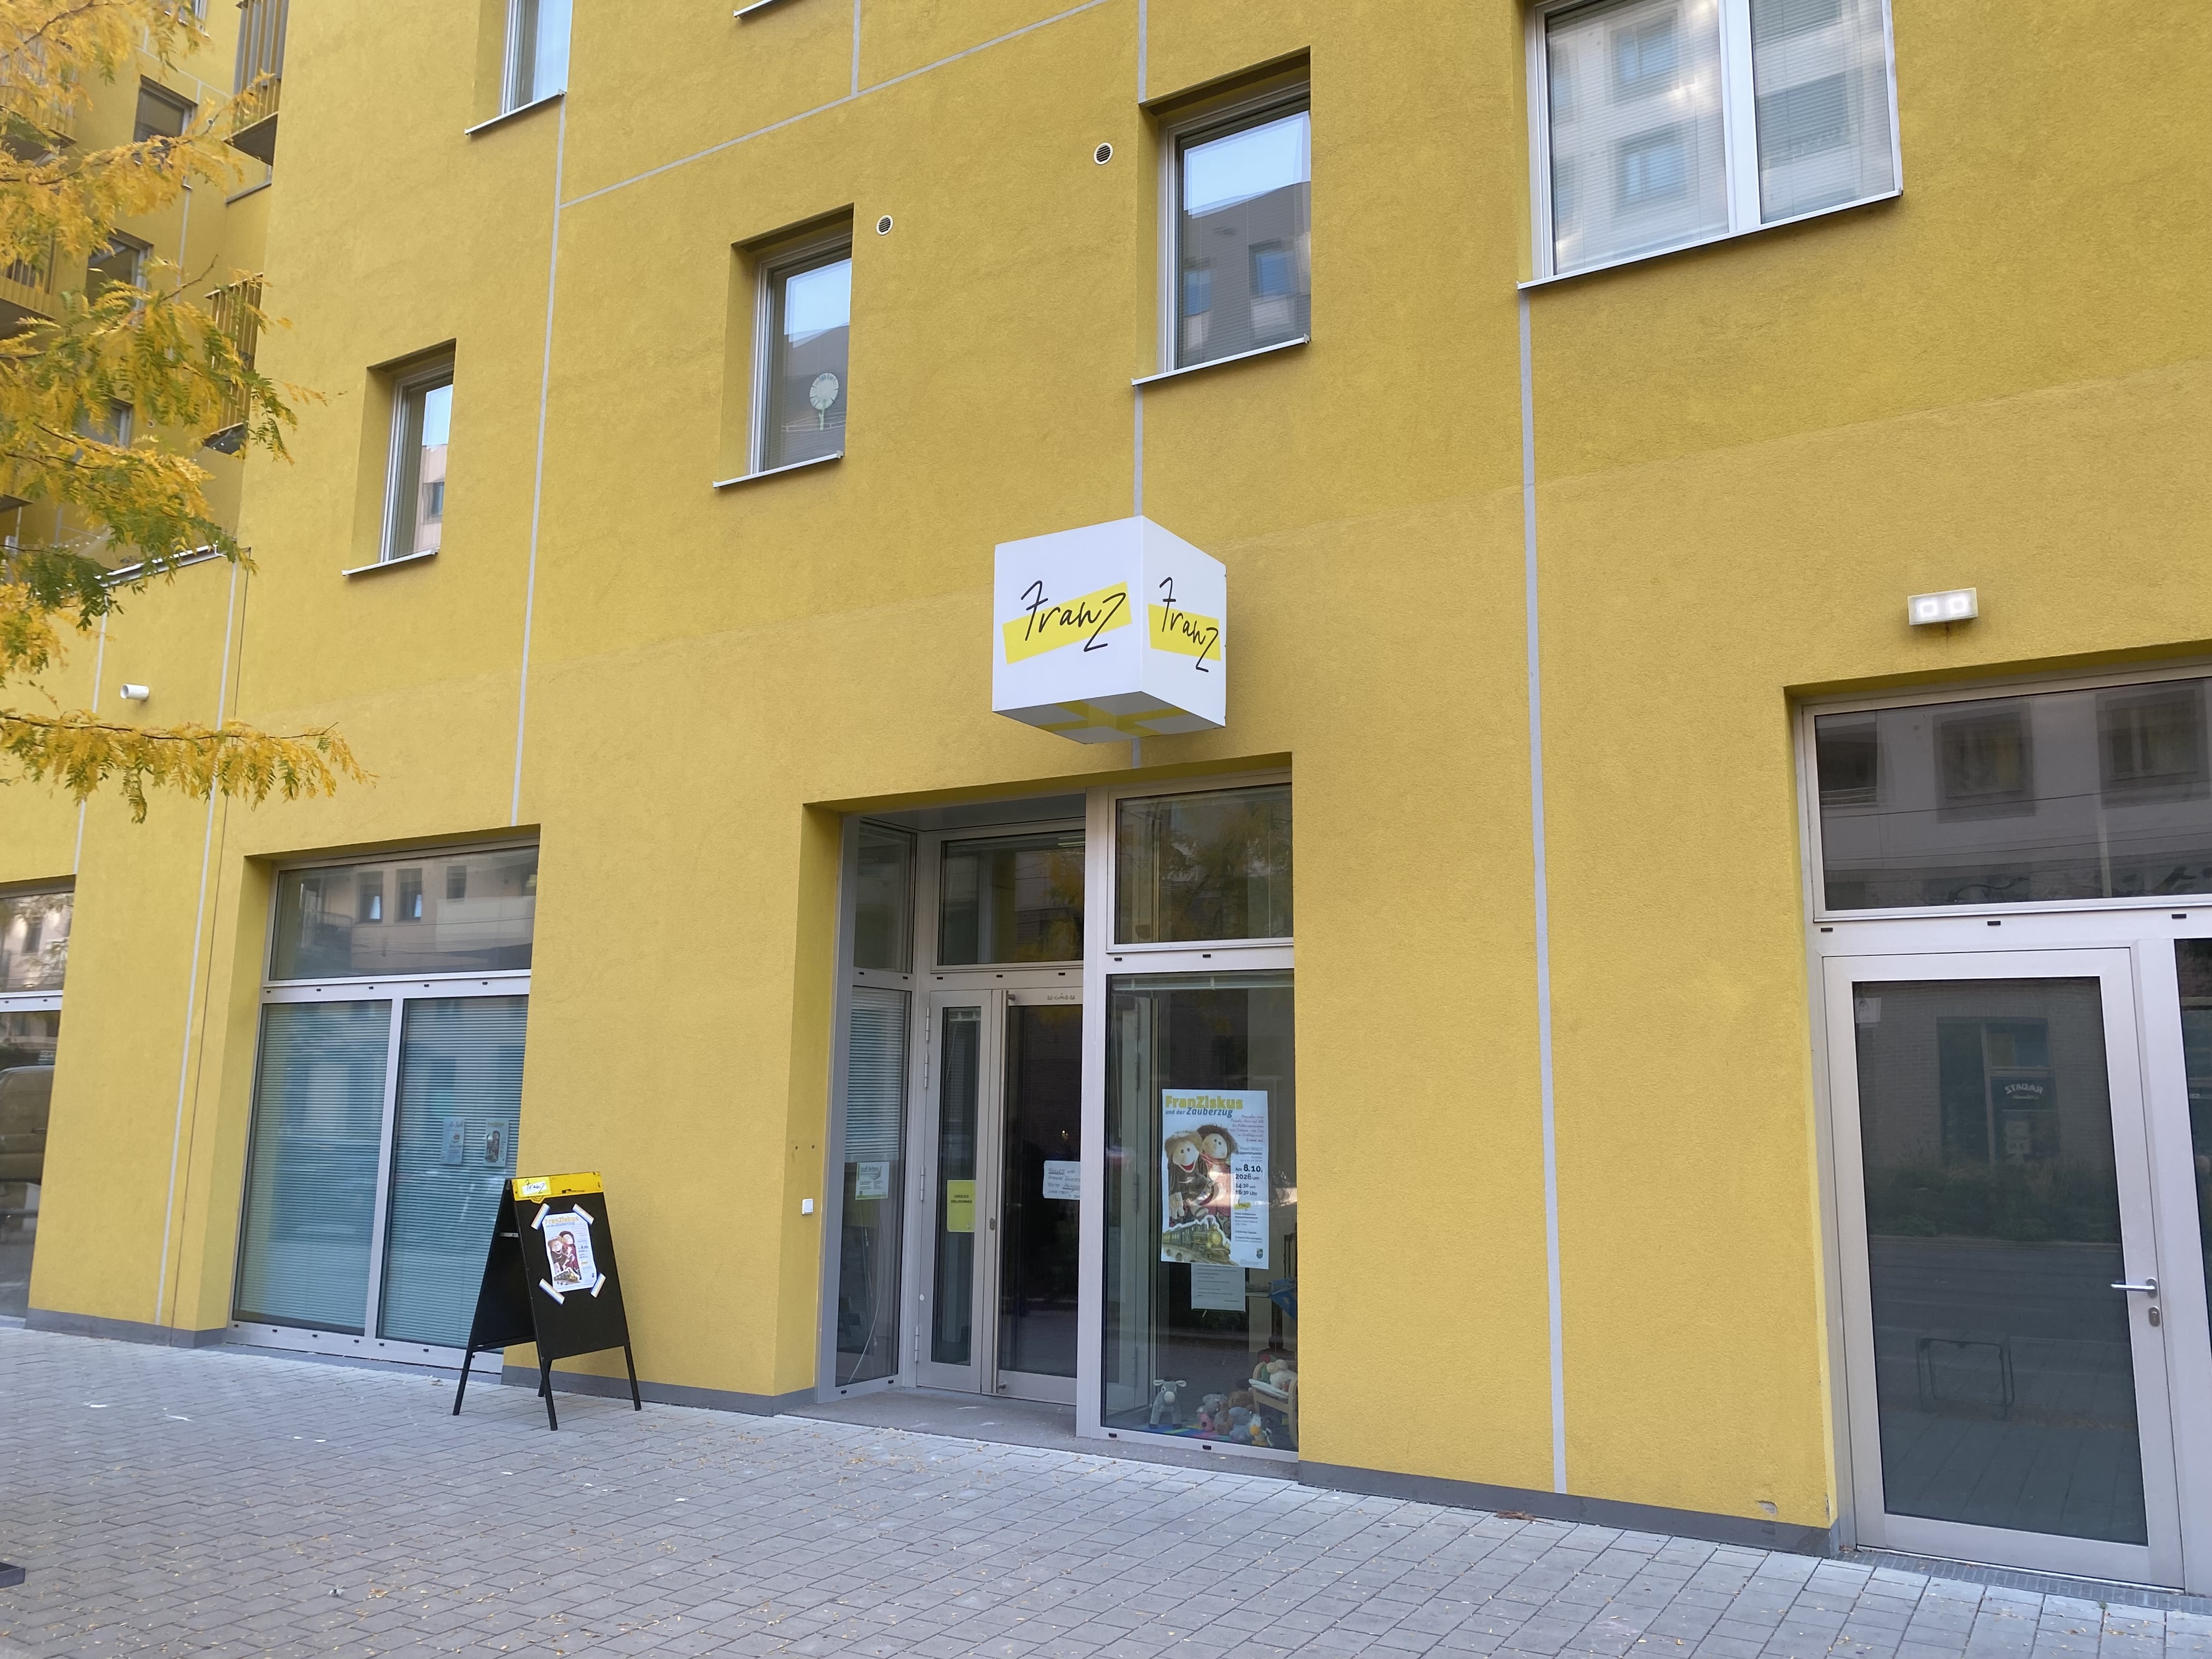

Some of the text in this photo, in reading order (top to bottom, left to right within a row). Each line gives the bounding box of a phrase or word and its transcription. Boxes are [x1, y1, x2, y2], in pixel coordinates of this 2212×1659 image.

[1020, 580, 1127, 652] FranZ
[1159, 576, 1219, 673] FranZ
[1165, 1095, 1243, 1109] FranZiskus
[1186, 1107, 1233, 1118] Zauberzug
